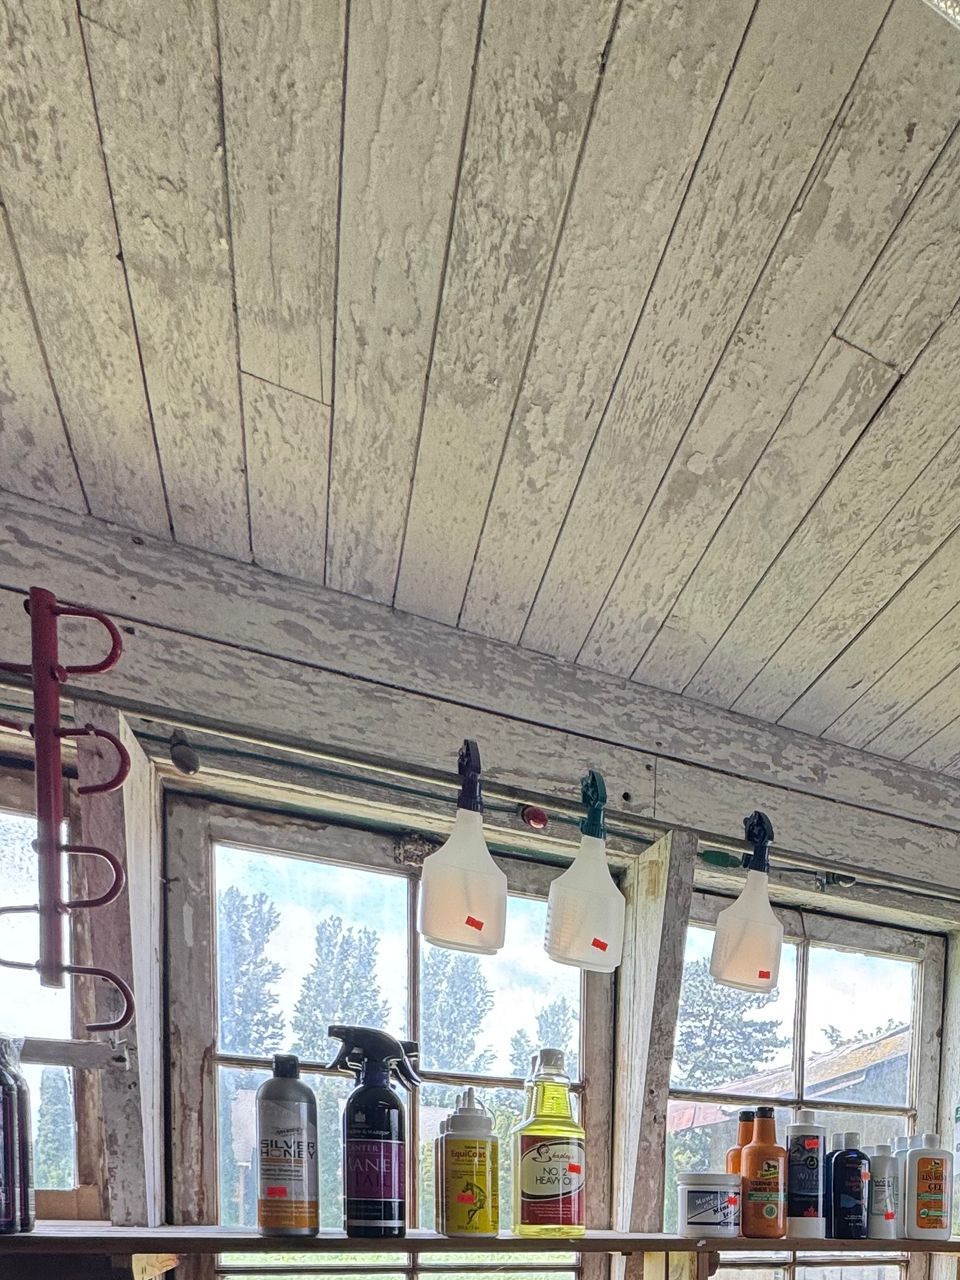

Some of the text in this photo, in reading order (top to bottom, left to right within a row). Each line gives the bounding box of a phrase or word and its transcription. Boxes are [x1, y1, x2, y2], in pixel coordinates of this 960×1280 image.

[261, 1139, 316, 1151] SILVER
[261, 1149, 317, 1160] HONEY
[451, 1149, 486, 1159] EquiCoat
[562, 1168, 569, 1177] 2
[535, 1177, 561, 1185] HEAVY
